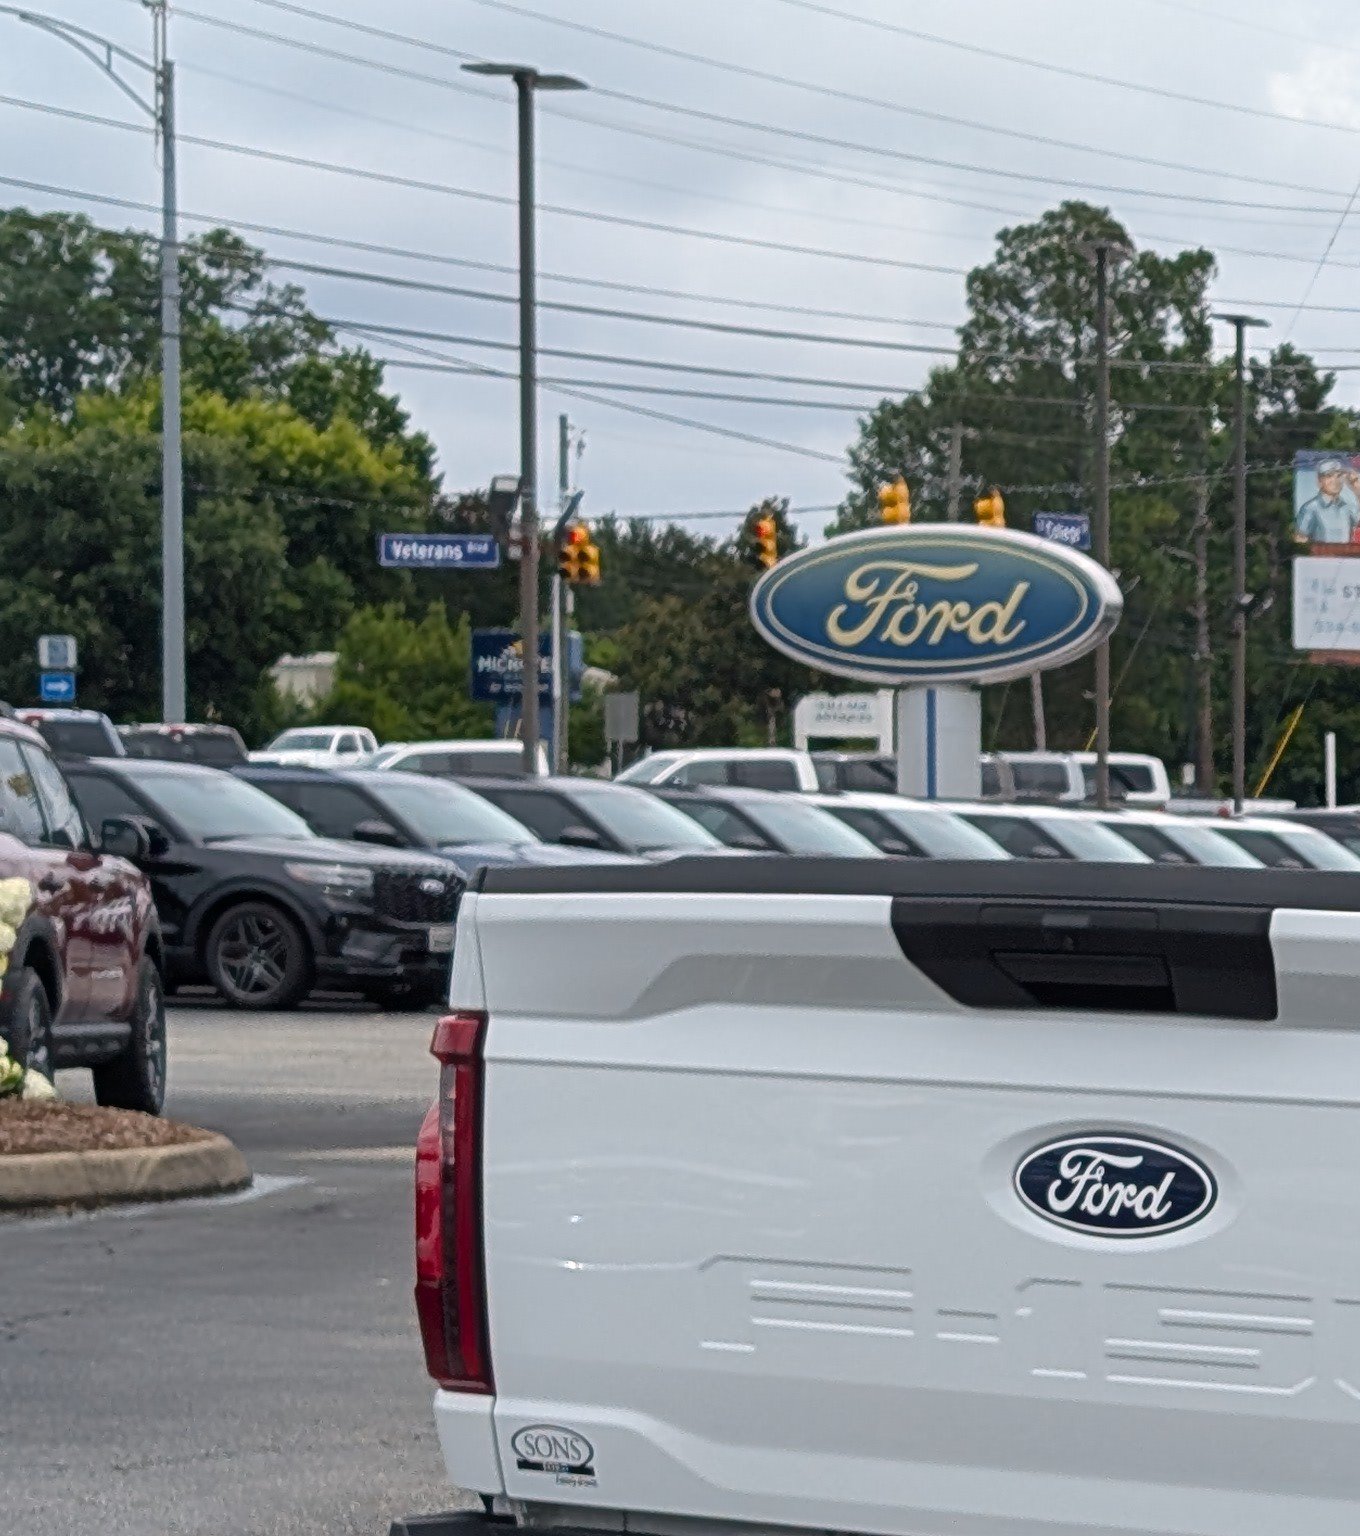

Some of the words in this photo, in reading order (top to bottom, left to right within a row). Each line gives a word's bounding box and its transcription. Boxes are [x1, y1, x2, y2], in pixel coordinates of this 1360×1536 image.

[392, 540, 464, 560] Veterans
[827, 561, 1029, 647] Ford
[1048, 1149, 1176, 1219] Ford
[524, 1433, 582, 1461] SONS
